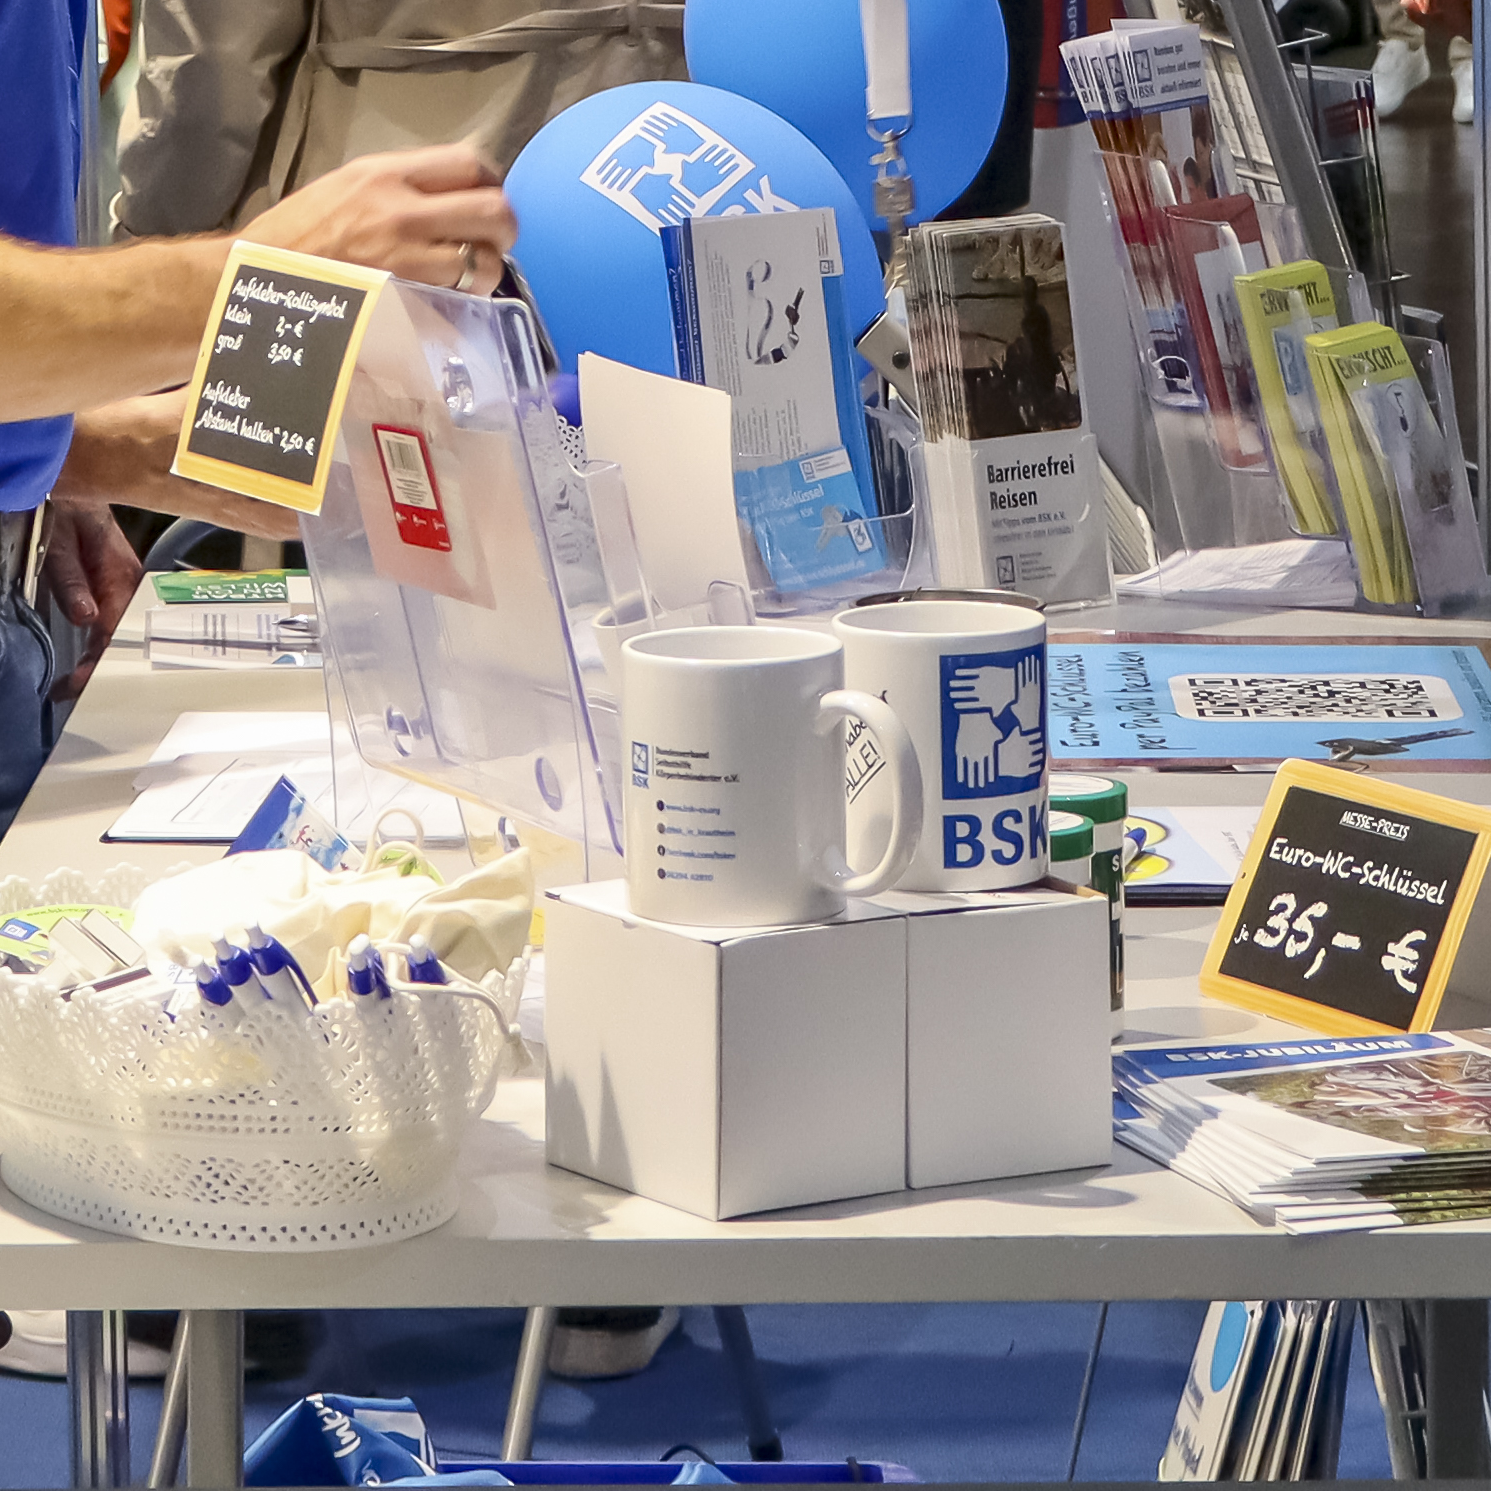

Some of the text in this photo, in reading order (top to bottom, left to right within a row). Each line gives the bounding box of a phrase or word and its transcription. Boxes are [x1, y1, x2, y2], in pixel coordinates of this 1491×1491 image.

[224, 304, 252, 326] klein
[294, 320, 306, 339] €
[214, 334, 305, 367] groß 3,50 €
[201, 380, 252, 410] Aufkleber
[280, 430, 304, 455] 2,50
[304, 437, 316, 457] €
[986, 453, 1076, 485] Barrierefrei
[989, 488, 1039, 512] Reisen
[1048, 654, 1100, 747] Euro-WC-Schlüssel
[1103, 650, 1198, 750] per PayPal bezahlen
[943, 801, 1048, 870] BSK
[1339, 810, 1411, 842] MESSE-PREIS
[1268, 837, 1448, 906] Euro-WC-Schlüssel
[1233, 892, 1428, 994] je 35,- €
[1165, 1034, 1415, 1064] BSK-JUBILÄUM
